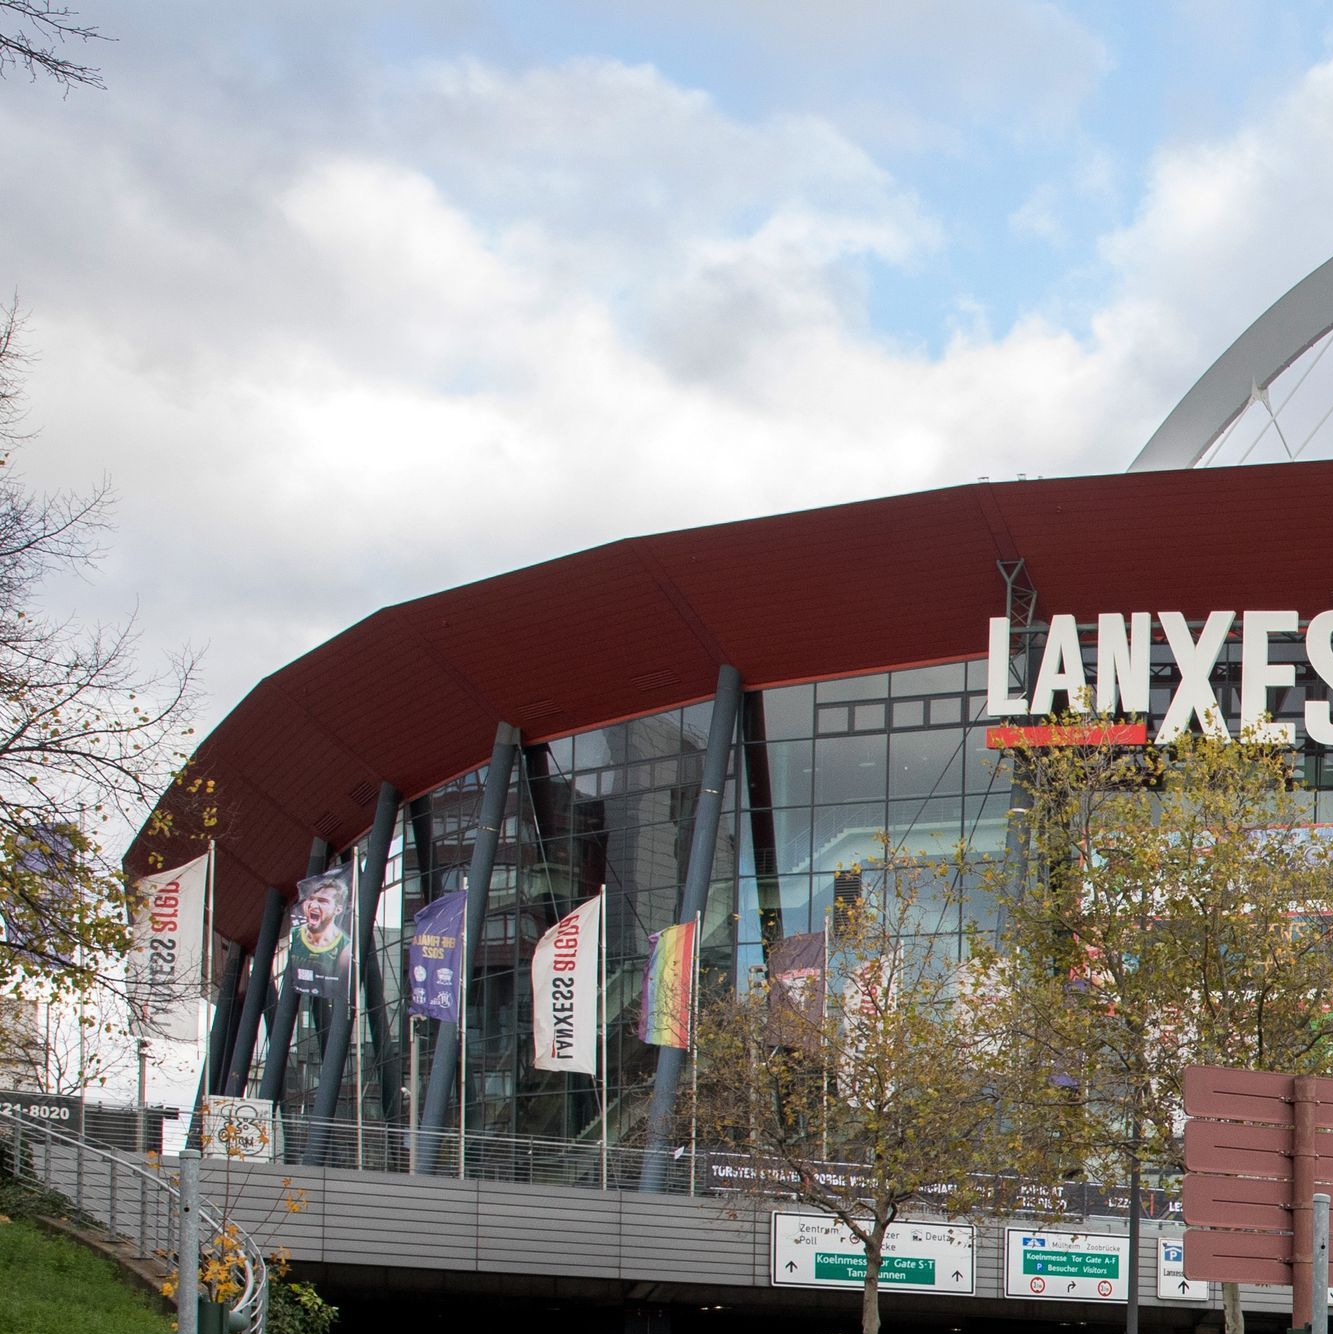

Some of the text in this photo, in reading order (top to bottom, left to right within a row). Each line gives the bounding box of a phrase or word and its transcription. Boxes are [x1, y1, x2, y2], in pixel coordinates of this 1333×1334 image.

[0, 1102, 70, 1120] 21-8020
[800, 1223, 839, 1235] Zentrum
[800, 1235, 817, 1246] Poll
[1052, 1241, 1121, 1252] Mülheim Zoobrücke
[816, 1254, 867, 1266] Koelnmess
[881, 1259, 890, 1267] or
[894, 1257, 916, 1269] Gate
[1026, 1252, 1067, 1263] Koelnmesse
[1071, 1255, 1082, 1263] Tor
[1085, 1255, 1102, 1265] Gate
[1047, 1263, 1079, 1274] Besucher
[1083, 1265, 1108, 1275] Visitors
